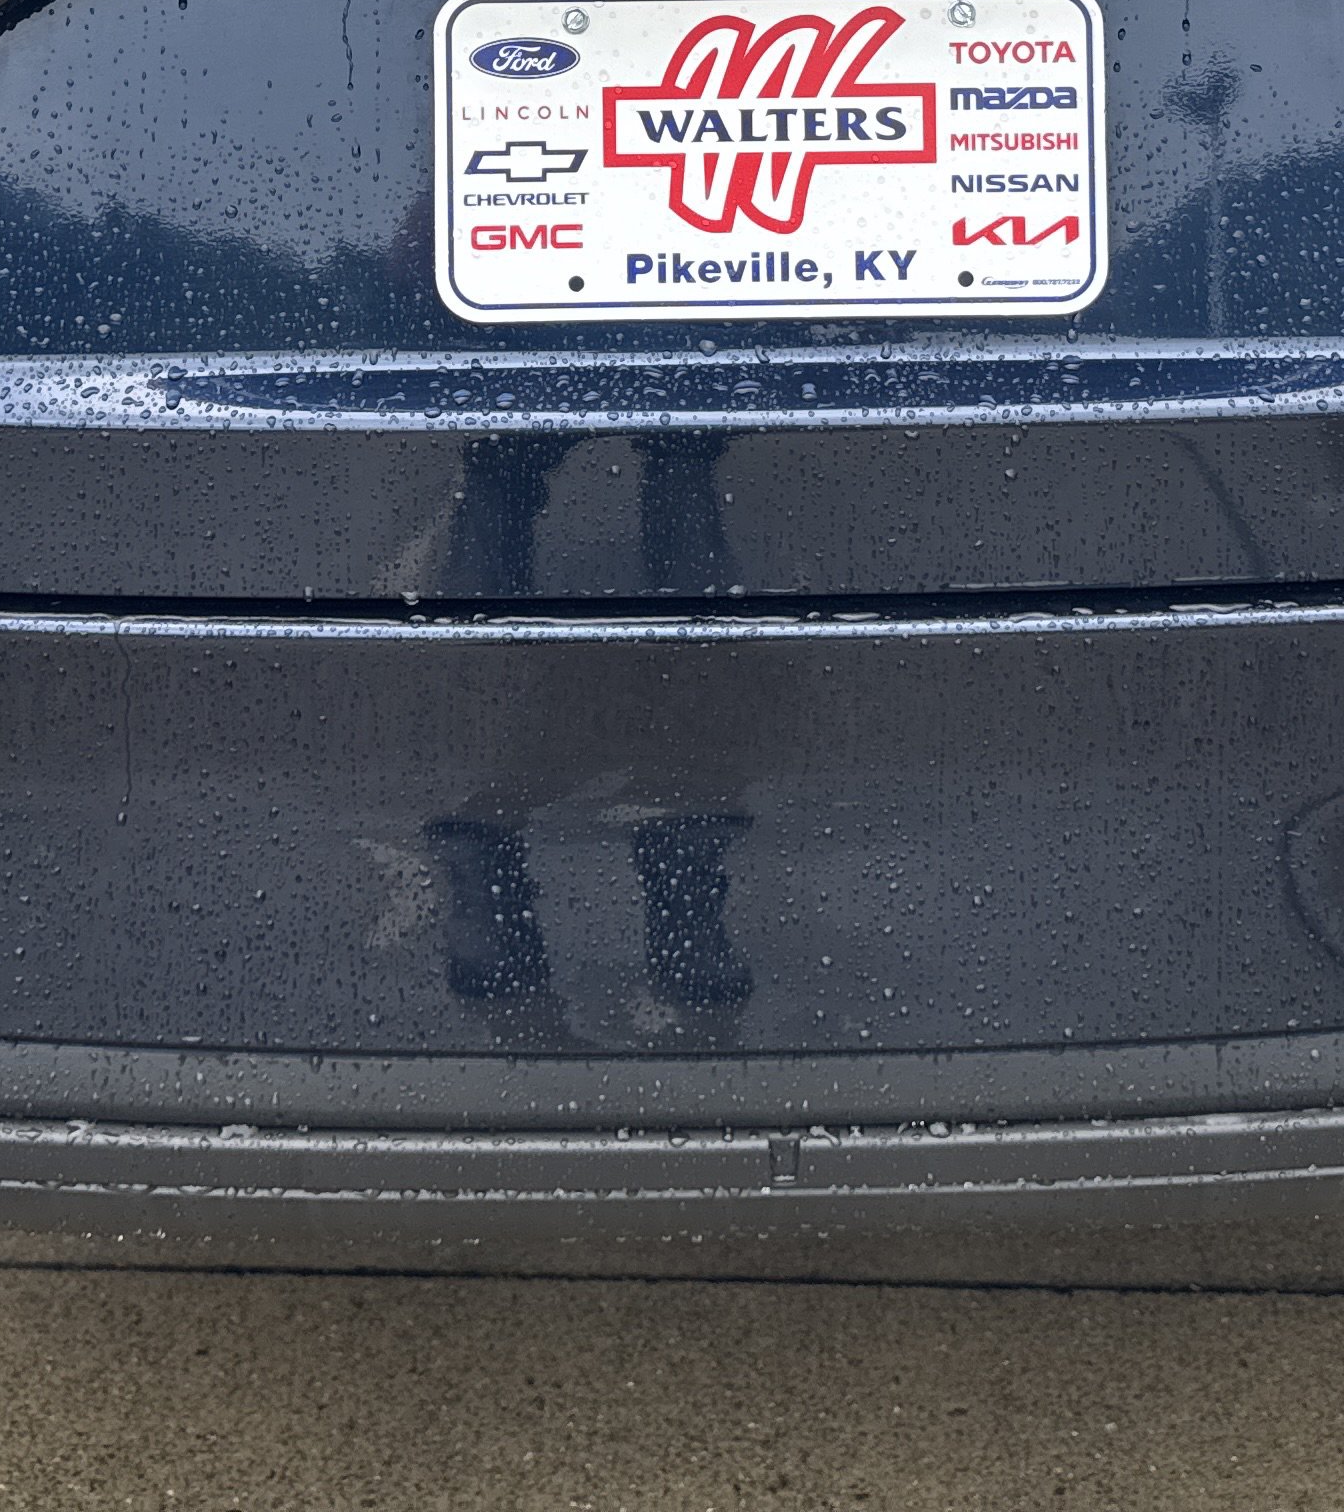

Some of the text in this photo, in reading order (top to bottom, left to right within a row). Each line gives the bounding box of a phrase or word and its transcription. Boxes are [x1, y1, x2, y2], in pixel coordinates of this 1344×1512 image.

[492, 45, 557, 72] Ford
[949, 41, 1076, 64] TOYOTA
[462, 105, 589, 120] LINCOLN
[636, 107, 907, 143] WALTERS
[950, 133, 1078, 151] MITSUBISHI
[951, 174, 1079, 193] NISSAN
[463, 192, 590, 207] CHEVROLET
[471, 224, 584, 251] GMC
[626, 250, 917, 289] Pikeville, KY
